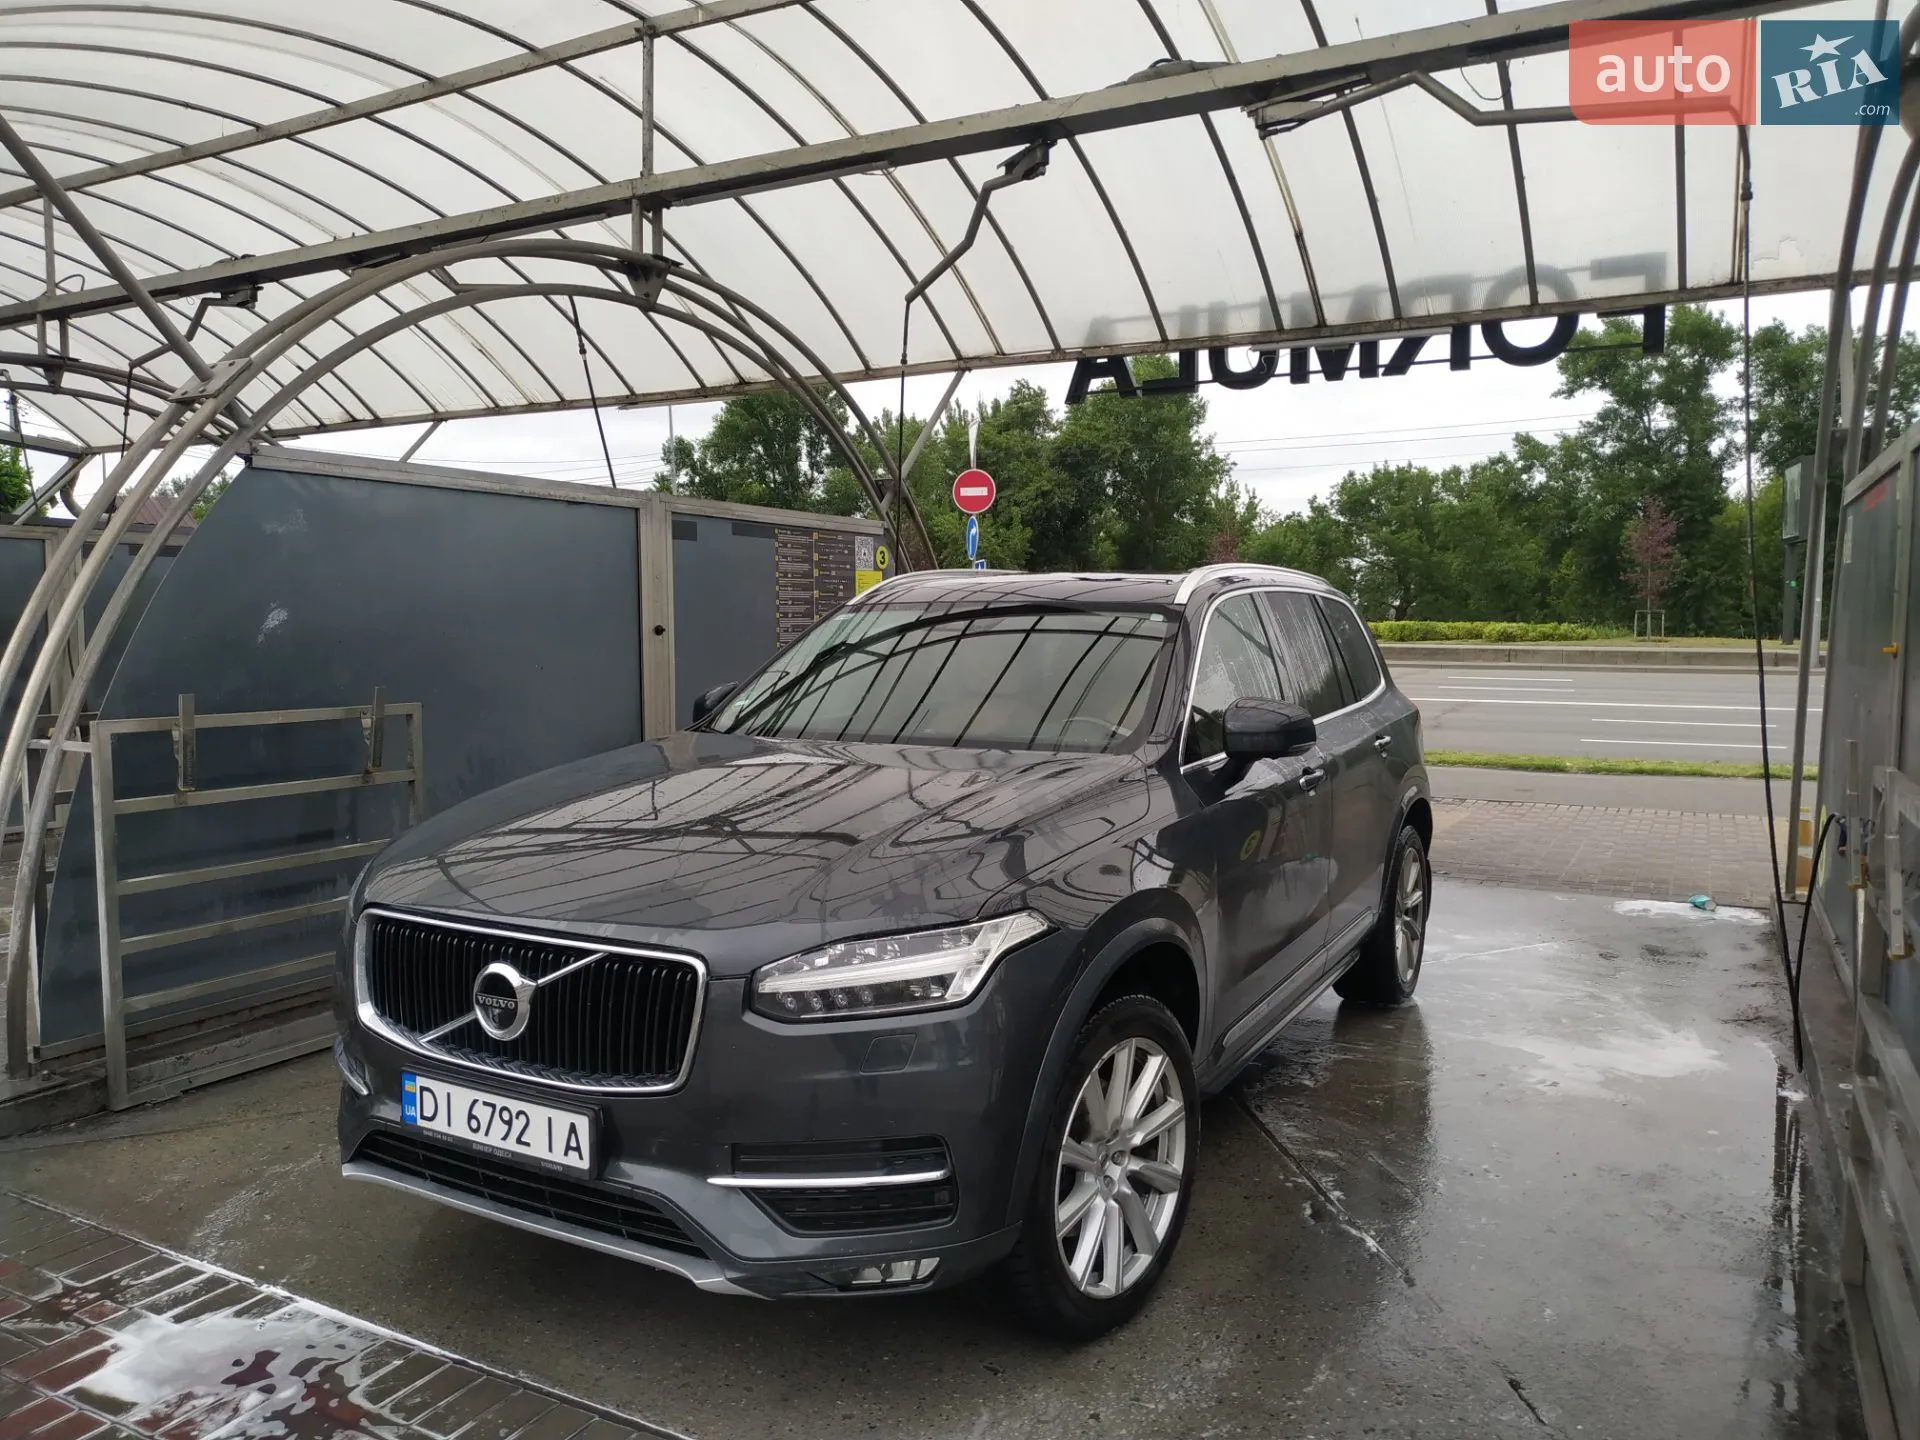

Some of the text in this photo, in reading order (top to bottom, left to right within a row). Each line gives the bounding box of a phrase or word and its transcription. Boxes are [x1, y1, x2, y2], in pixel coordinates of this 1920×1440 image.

[879, 550, 886, 565] 3
[477, 995, 515, 1010] VOLVO
[405, 1104, 416, 1116] UA
[419, 1085, 584, 1160] DI 6792 IA
